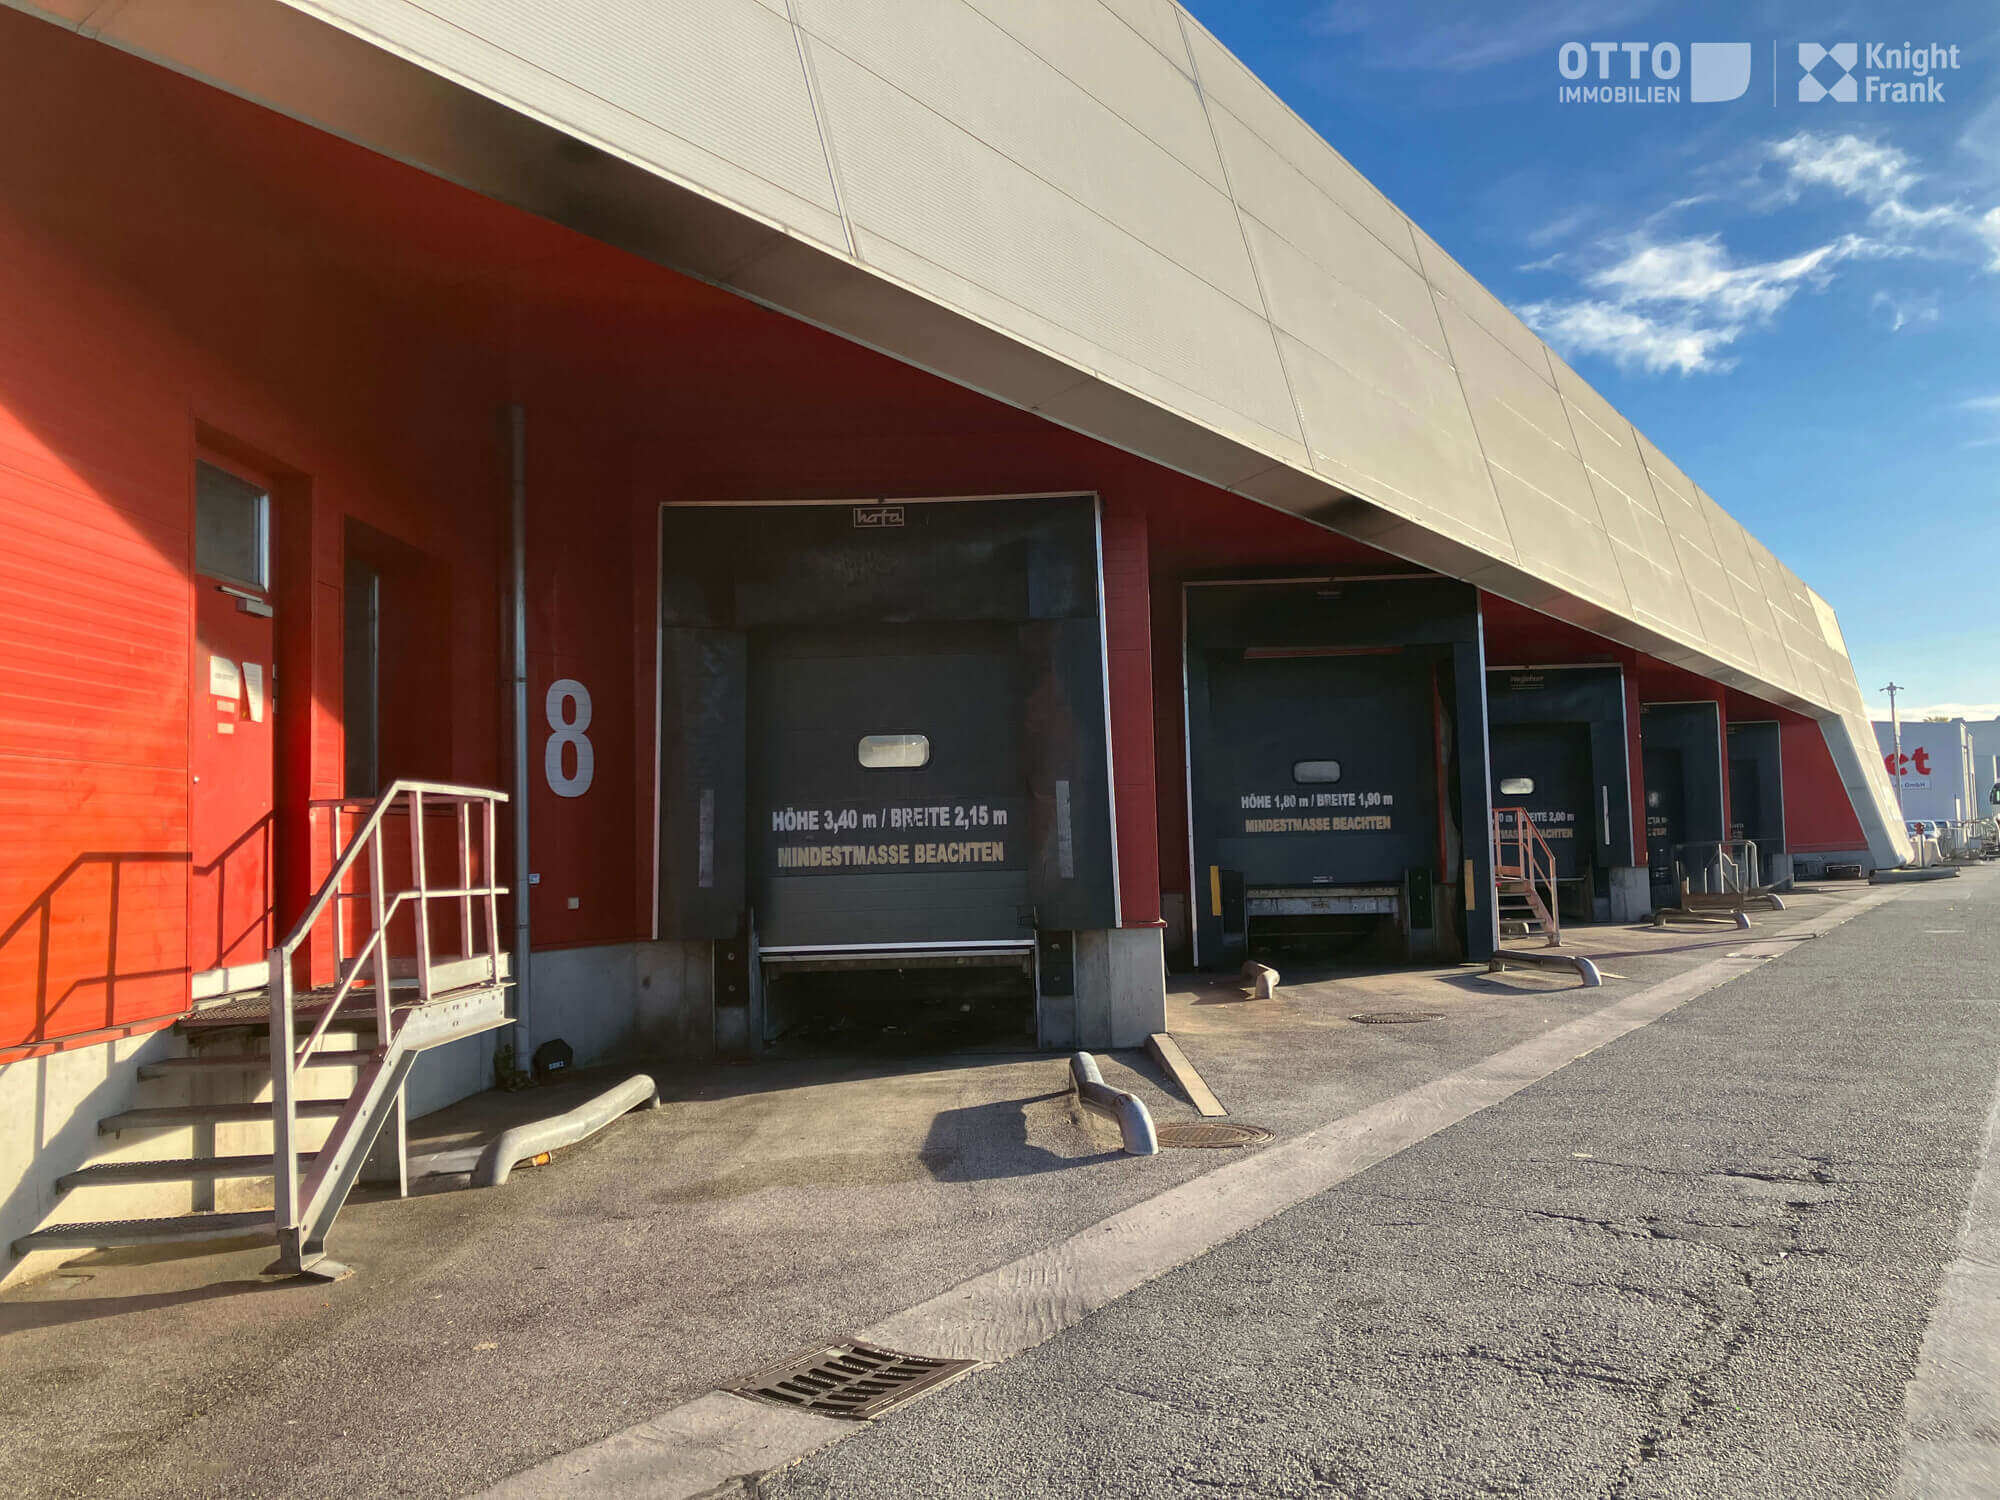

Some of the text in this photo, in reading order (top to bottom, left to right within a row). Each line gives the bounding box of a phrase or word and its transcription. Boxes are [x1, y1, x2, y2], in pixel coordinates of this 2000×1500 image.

[545, 678, 594, 798] 8
[1241, 793, 1272, 809] HÖHE
[1299, 797, 1309, 808] m
[1317, 793, 1356, 808] BREITE
[1358, 792, 1381, 808] 1,90
[1383, 795, 1393, 805] m
[772, 805, 1008, 833] HÖHE 3,40 m / BREITE 2,15 m
[1245, 816, 1391, 833] MINDESTMASSE BEACHTEN
[778, 841, 1004, 867] MINDESTMASSE BEACHTEN
